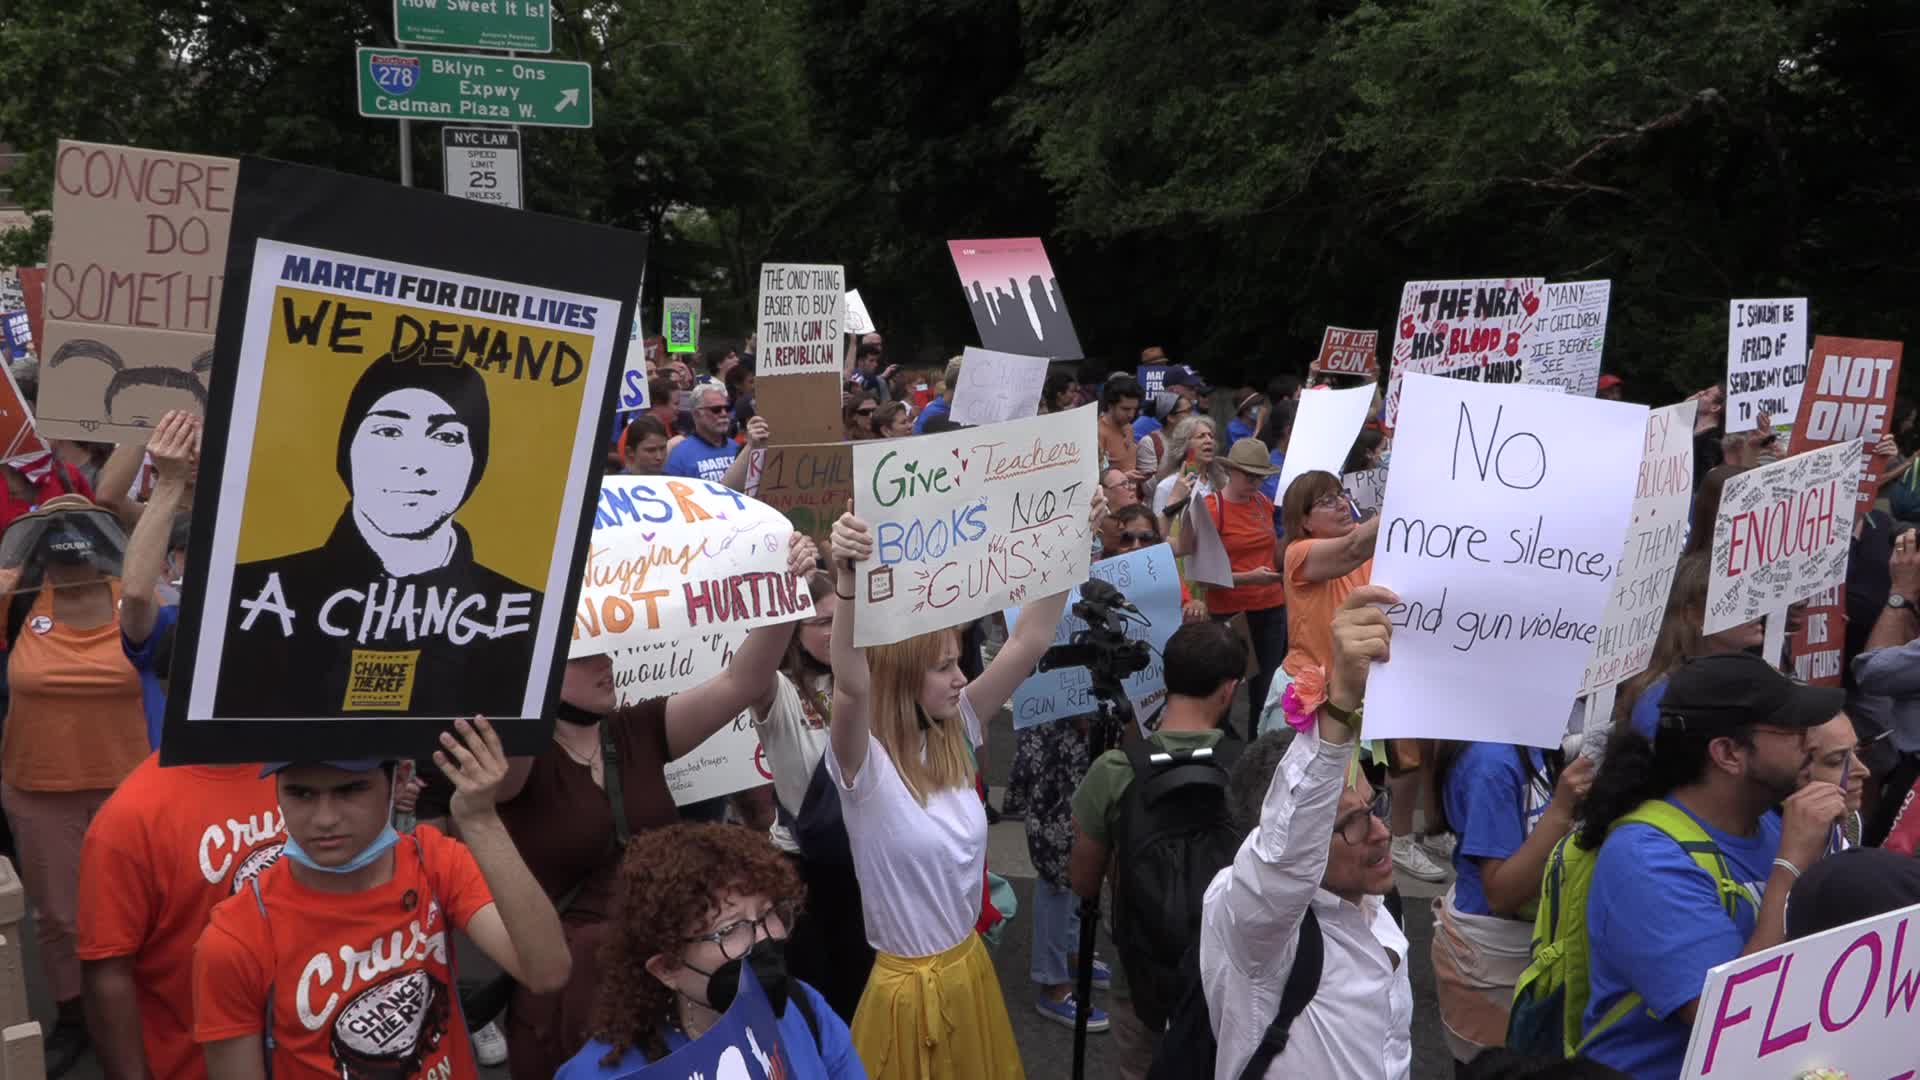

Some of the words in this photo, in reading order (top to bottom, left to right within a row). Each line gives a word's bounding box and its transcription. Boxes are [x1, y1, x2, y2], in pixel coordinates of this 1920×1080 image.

[448, 0, 497, 14] Sweet
[505, 2, 518, 16] It
[525, 3, 545, 17] Is!
[379, 66, 413, 87] 278
[432, 59, 485, 78] Bklyn
[459, 80, 520, 100] Expwy
[375, 96, 451, 113] Cadman
[460, 101, 509, 117] Plaza
[519, 103, 537, 118] W.
[454, 132, 479, 145] NYC
[482, 133, 509, 145] LAW
[467, 150, 497, 159] SPEED
[471, 161, 494, 169] LIMIT
[469, 171, 497, 189] 25
[465, 191, 502, 200] UNLESS
[146, 214, 209, 255] DO
[281, 254, 397, 297] MARCH
[398, 275, 458, 308] FOR
[460, 285, 520, 317] OUR
[522, 295, 598, 330] LIVES
[765, 269, 784, 290] THE
[49, 262, 225, 329] SOMETH
[764, 296, 793, 316] EASIER
[796, 296, 810, 315] TO
[814, 295, 837, 315] BUY
[1418, 288, 1473, 322] THE
[1474, 287, 1520, 318] NRA
[1546, 284, 1586, 307] MANY
[1550, 312, 1601, 333] CHILDREN
[1737, 304, 1744, 327] I
[1783, 304, 1794, 323] BE
[282, 297, 372, 354] WE
[391, 313, 583, 387] DEMAND
[763, 321, 790, 342] THAN
[793, 321, 799, 342] A
[801, 321, 822, 342] GUN
[826, 319, 837, 340] IS
[1329, 331, 1350, 345] MY
[1351, 333, 1375, 347] LIFE
[764, 347, 773, 368] A
[775, 344, 834, 368] REPUBLICAN
[1410, 332, 1445, 360] HAS
[1449, 327, 1502, 356] BLOOD
[1558, 337, 1594, 355] BEFORE
[1740, 335, 1772, 363] AFRAID
[1775, 333, 1787, 357] OF
[1484, 358, 1522, 384] HANDS
[1541, 358, 1565, 374] SEE
[1816, 355, 1893, 399] NOT
[1730, 369, 1767, 395] SENDING
[1767, 366, 1782, 389] MY
[1739, 402, 1751, 421] TO
[1758, 396, 1789, 417] SCHOOL
[1806, 400, 1888, 444] ONE
[795, 452, 853, 490] CHIL
[873, 451, 951, 507] Give
[878, 497, 988, 565] BOOKS
[1010, 481, 1083, 532] NOT
[1387, 517, 1491, 563] more
[1504, 515, 1613, 582] silence,
[1634, 520, 1681, 569] THEM
[240, 572, 296, 637] A
[318, 577, 532, 646] CHANGE
[573, 589, 670, 641] NOT
[683, 572, 812, 628] HURTING
[1386, 587, 1448, 635] end
[1453, 611, 1513, 652] gun
[355, 662, 409, 677] CHANGE
[615, 648, 694, 688] would
[354, 676, 376, 689] THE
[348, 976, 422, 1035] CHANGE
[363, 1013, 404, 1044] THE
